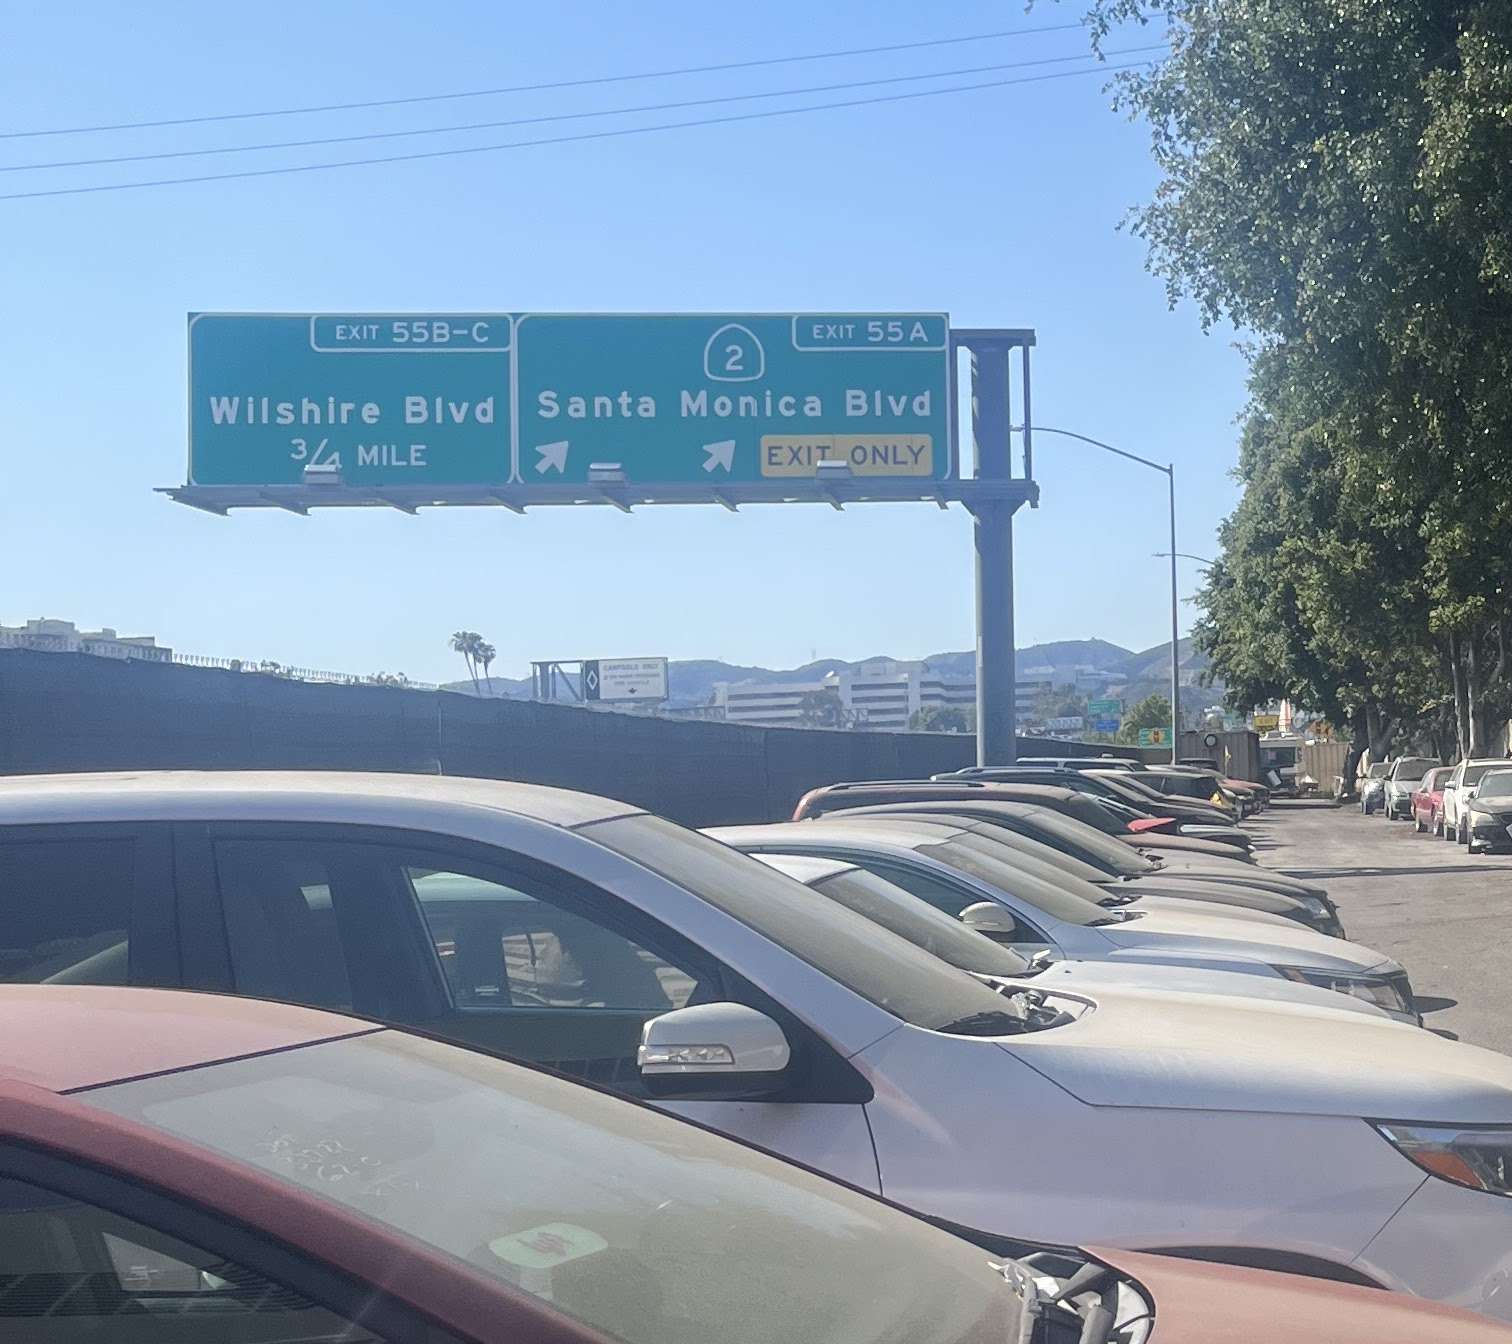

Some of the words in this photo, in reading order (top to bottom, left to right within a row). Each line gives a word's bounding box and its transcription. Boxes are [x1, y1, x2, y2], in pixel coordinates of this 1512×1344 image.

[335, 324, 380, 340] EXIT
[391, 321, 490, 343] 55B-C
[812, 324, 857, 339] EXIT
[867, 321, 929, 343] 55A
[725, 344, 744, 371] 2
[209, 395, 381, 425] Wilshire
[404, 395, 495, 425] Blvd
[537, 389, 657, 419] Santa
[680, 389, 823, 418] Monica
[845, 389, 932, 417] Blvd
[356, 444, 428, 467] MILE
[766, 445, 832, 466] EXIT
[850, 444, 927, 466] ONLY
